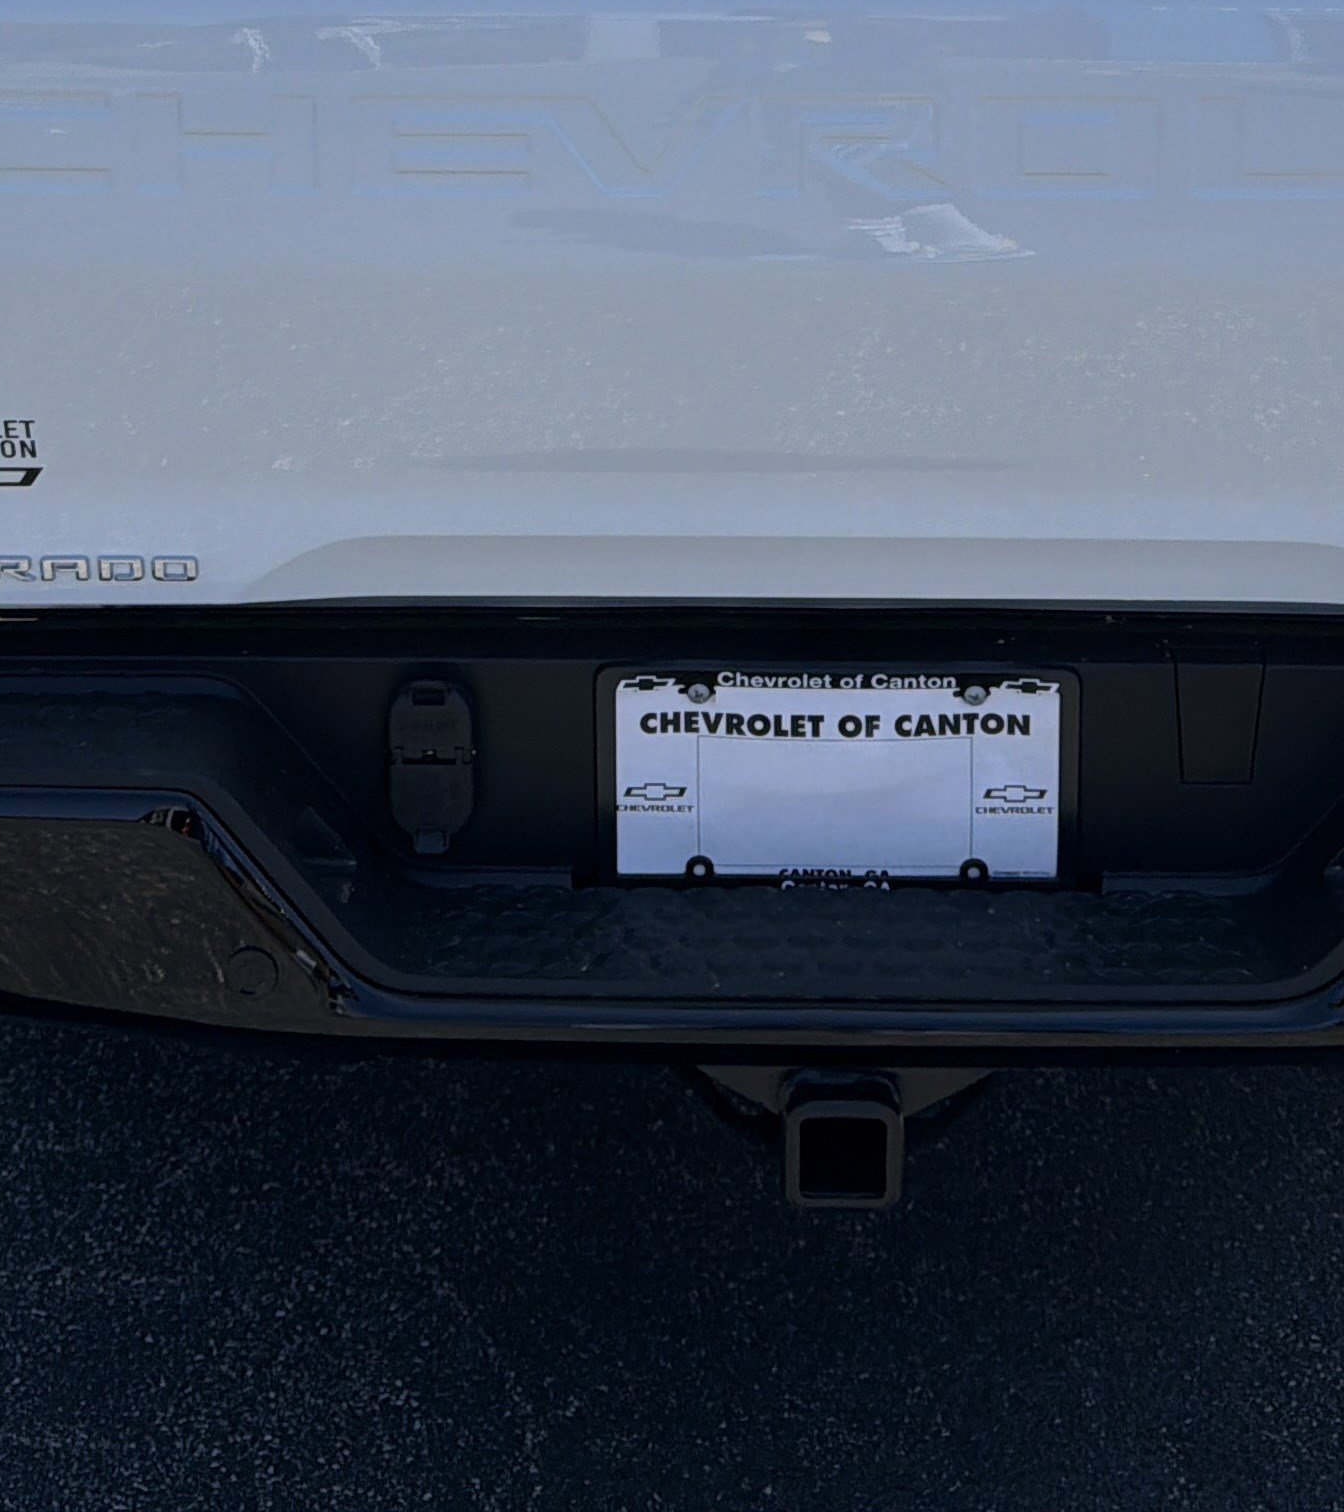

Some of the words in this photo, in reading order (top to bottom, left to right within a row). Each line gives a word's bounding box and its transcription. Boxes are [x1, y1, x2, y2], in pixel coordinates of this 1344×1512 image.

[716, 672, 832, 688] Chevrolet
[839, 674, 864, 688] of
[870, 674, 956, 689] Canton
[639, 712, 824, 736] CHEVROLET
[837, 714, 881, 737] OF
[894, 714, 1031, 736] CANTON
[616, 804, 694, 812] CHEVROLET
